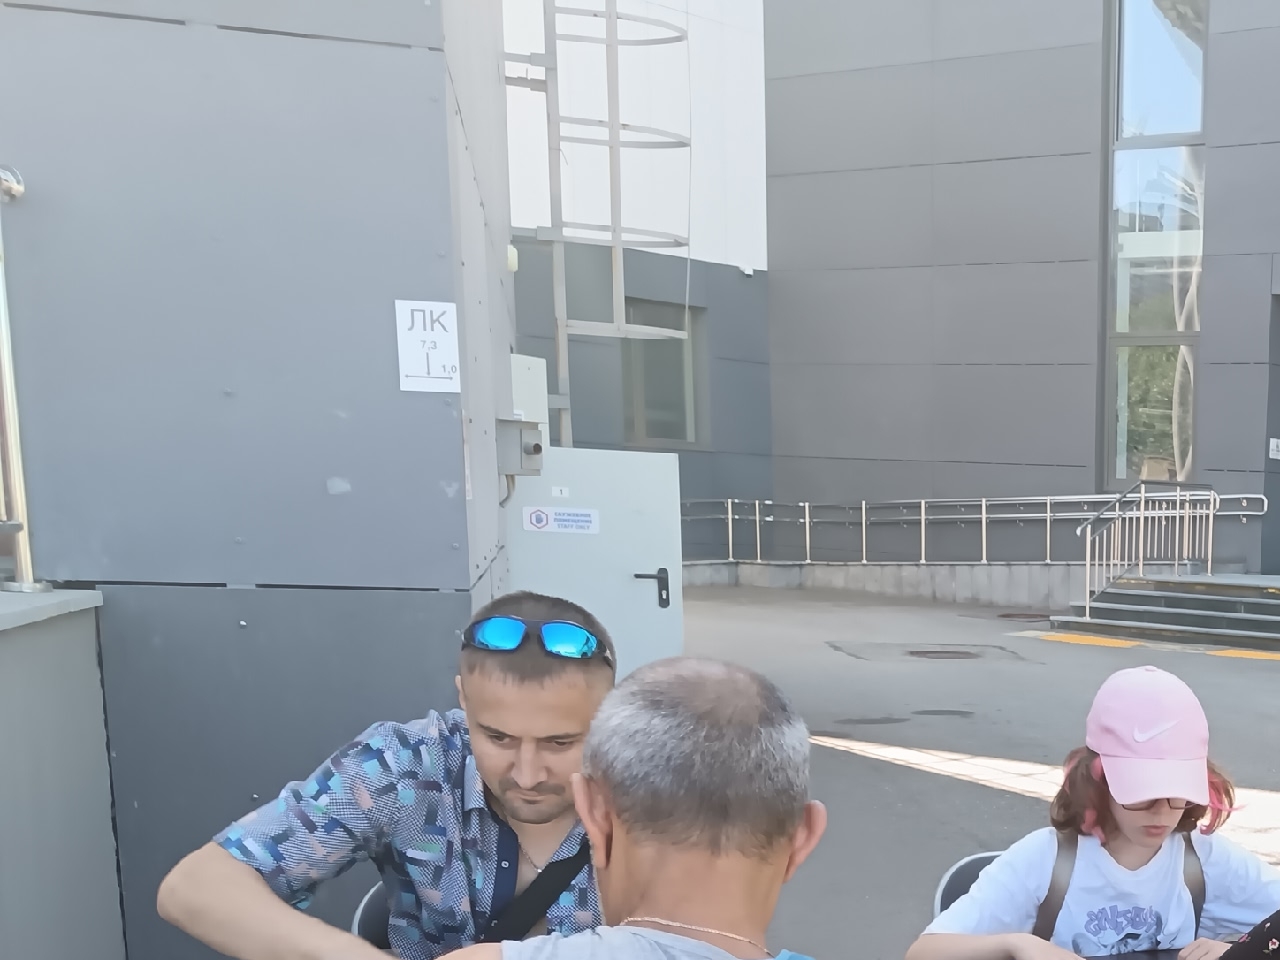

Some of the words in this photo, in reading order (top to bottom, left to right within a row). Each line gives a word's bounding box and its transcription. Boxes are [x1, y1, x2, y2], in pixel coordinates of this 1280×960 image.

[408, 309, 449, 333] ЛК
[420, 340, 437, 351] 7,3
[442, 364, 457, 375] 1,0
